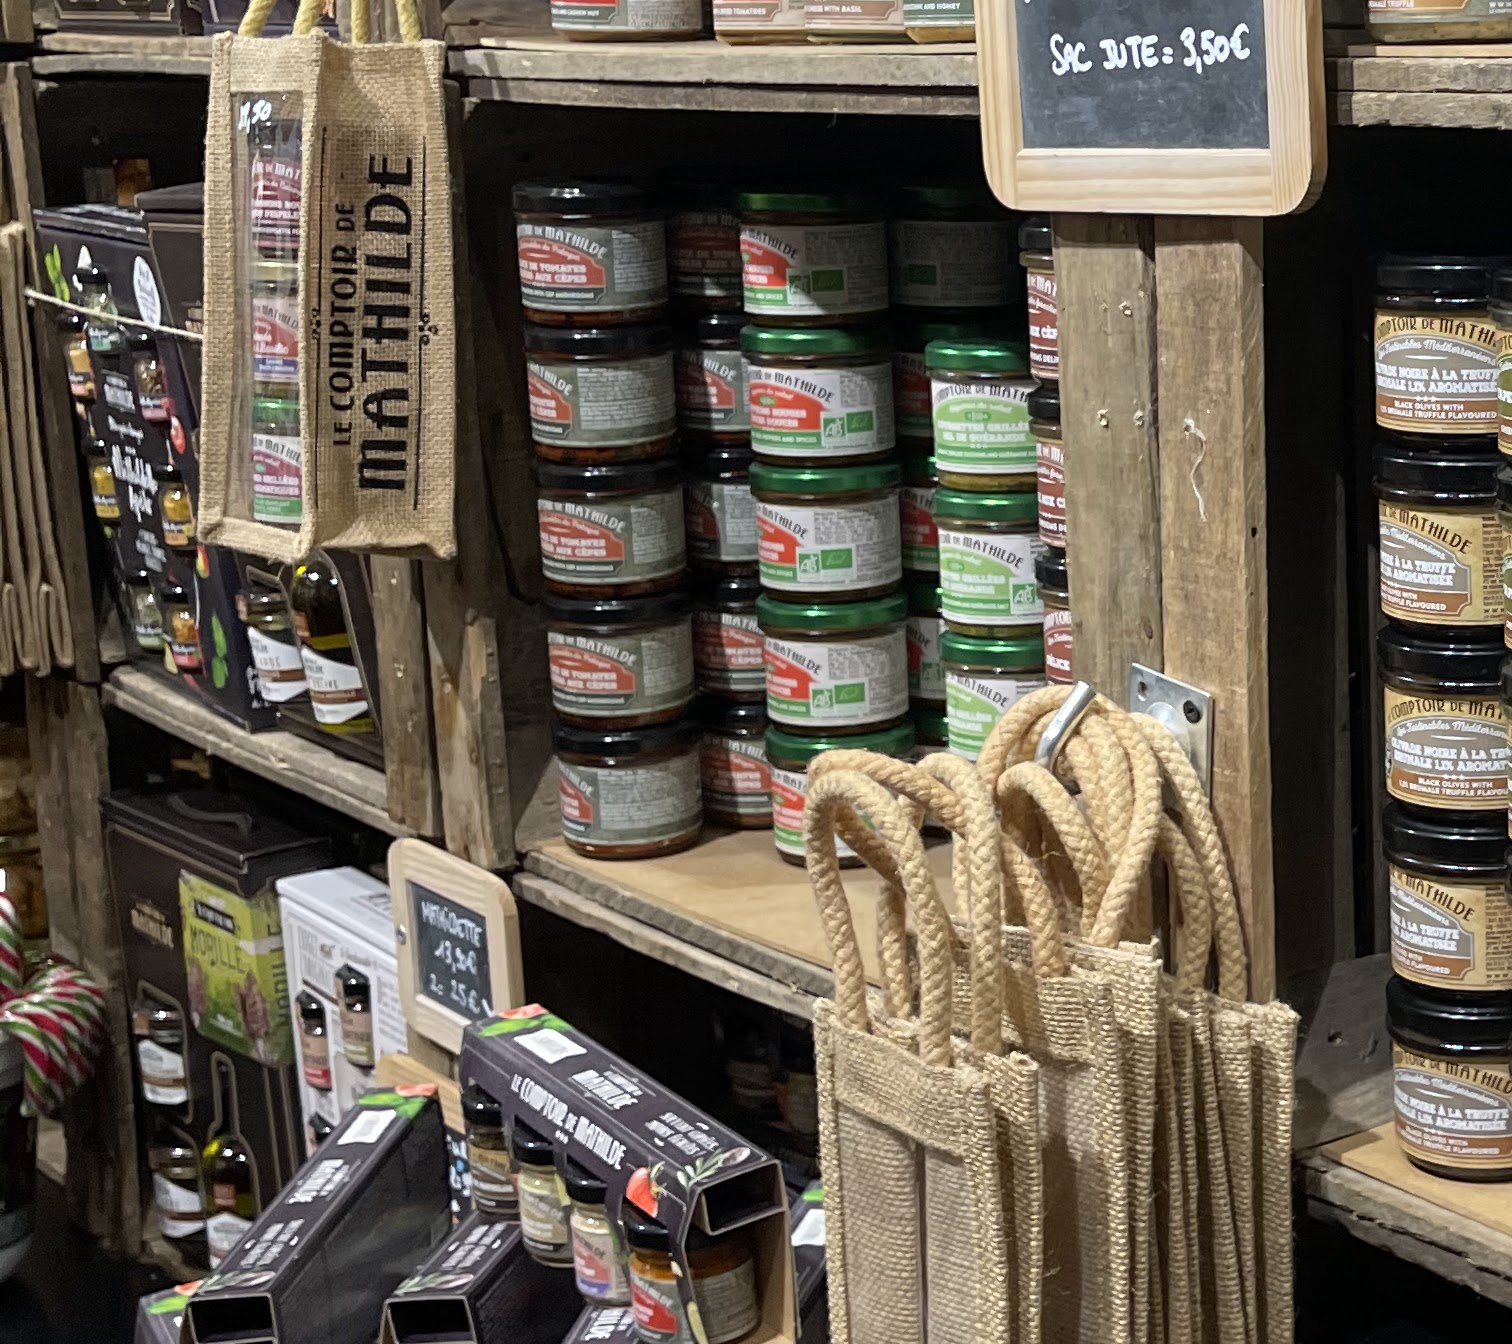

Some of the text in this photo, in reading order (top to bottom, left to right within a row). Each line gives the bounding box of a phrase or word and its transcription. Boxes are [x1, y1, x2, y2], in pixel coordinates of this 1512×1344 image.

[1050, 33, 1092, 76] SAC
[545, 227, 607, 260] MATHILDE
[329, 203, 358, 446] LE COMPTOIR DE
[358, 154, 413, 490] MATHILDE
[963, 537, 1024, 568] MATHILDE
[520, 1078, 568, 1127] COMPTOIR
[575, 1116, 626, 1170] MATHILDE
